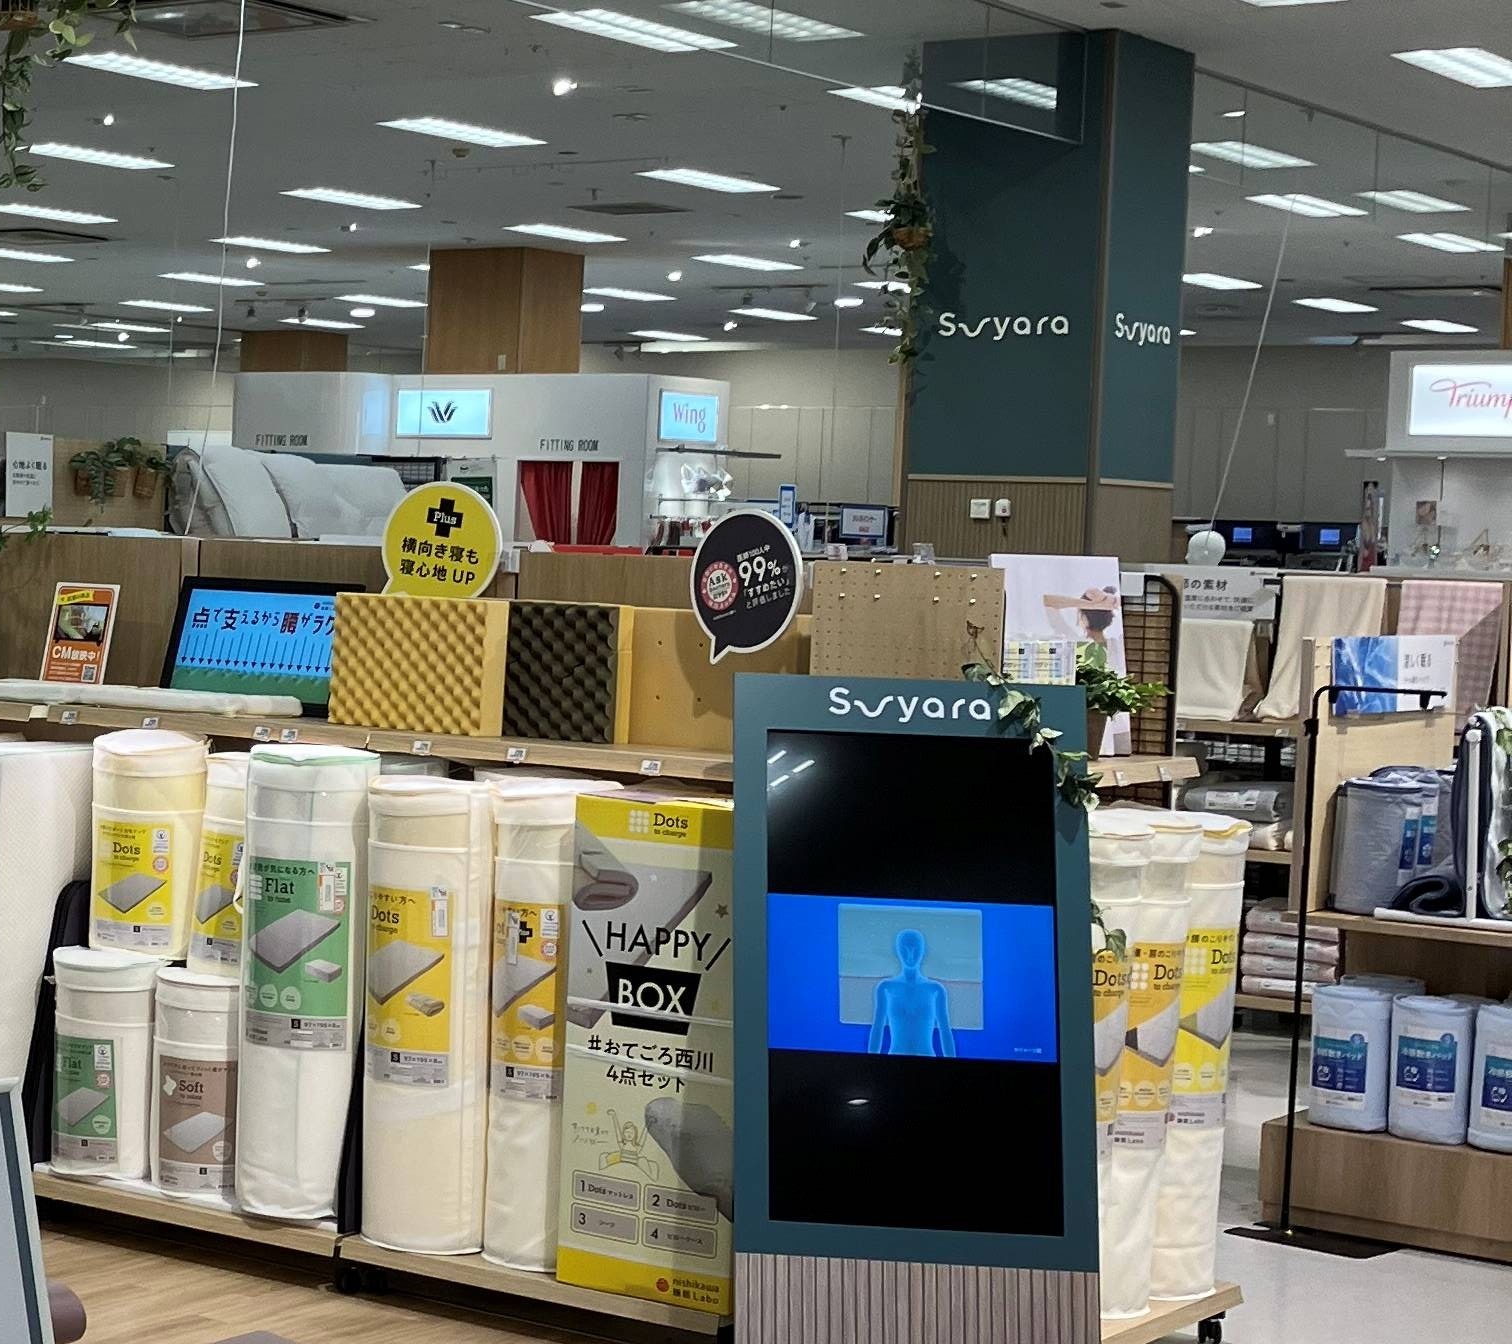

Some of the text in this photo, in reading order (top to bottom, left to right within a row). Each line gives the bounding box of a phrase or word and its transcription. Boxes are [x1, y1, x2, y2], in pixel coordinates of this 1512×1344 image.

[672, 401, 706, 434] Wing
[255, 434, 308, 446] FITTING ROOM
[539, 439, 599, 452] FITTING ROOM
[433, 512, 458, 525] Plus
[400, 537, 480, 565] 横向き寝も
[399, 558, 476, 586] 寝心地 UP
[653, 813, 689, 829] Dots
[112, 842, 141, 855] Dots
[265, 878, 295, 895] Flat
[372, 905, 399, 924] Dots
[606, 921, 712, 961] HAPPY
[617, 979, 687, 1016] BOX
[606, 1065, 686, 1092] 4点セット
[178, 1080, 204, 1094] Soft
[652, 1194, 660, 1207] 2
[578, 1213, 586, 1225] 3
[650, 1228, 659, 1239] 4
